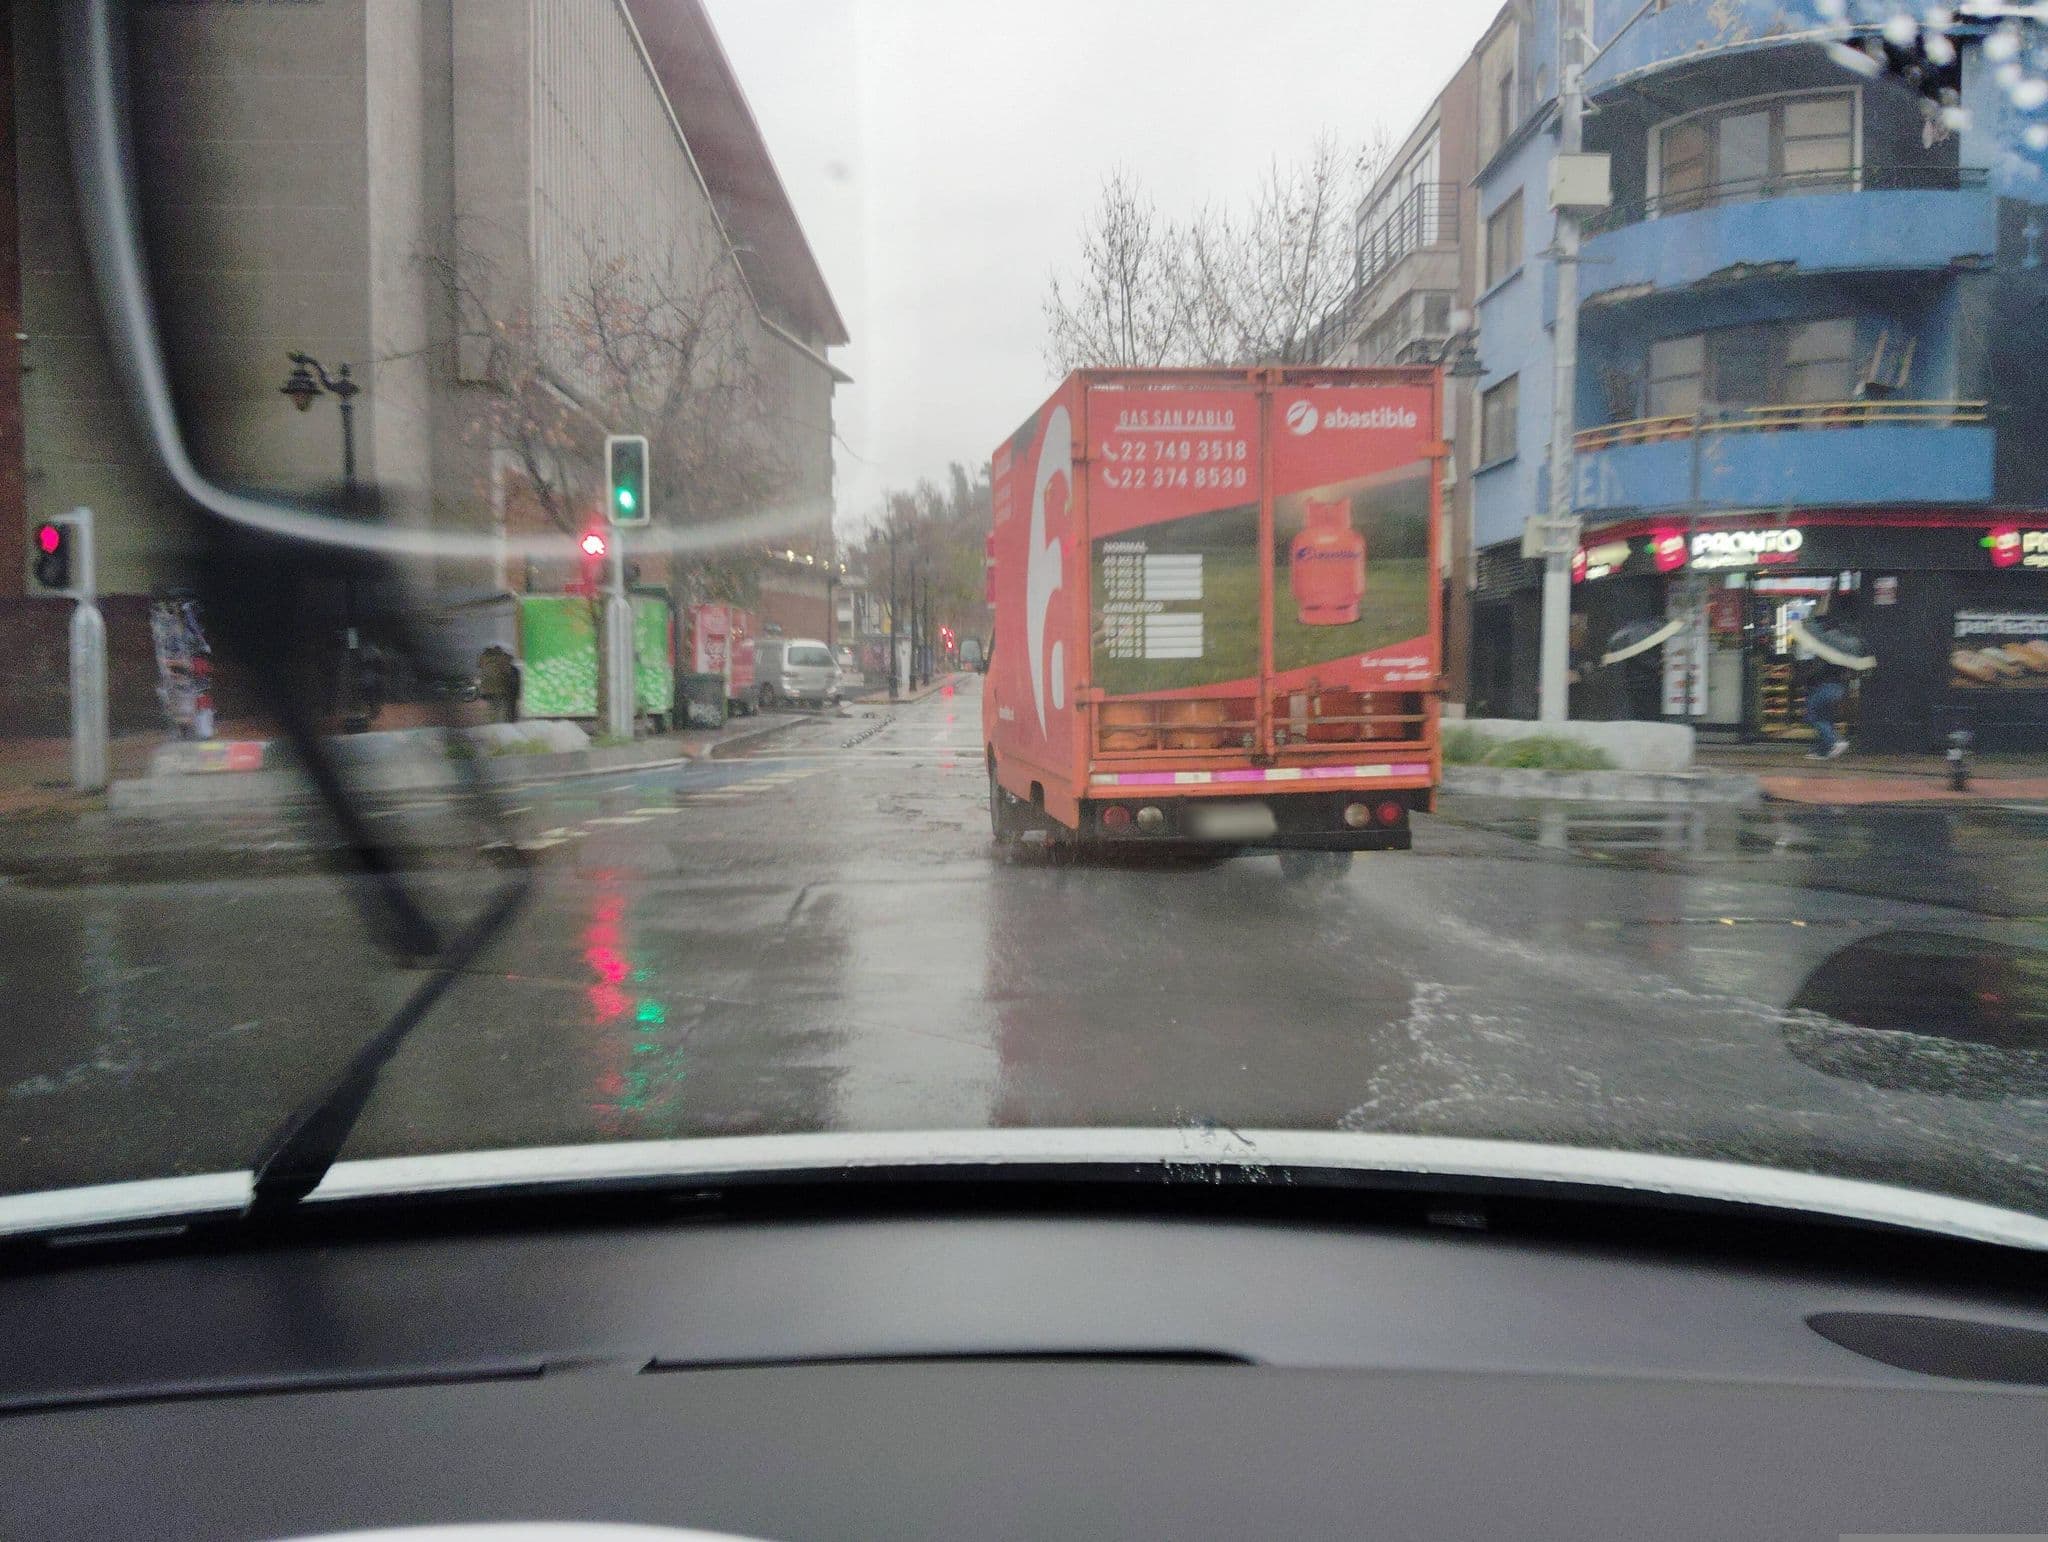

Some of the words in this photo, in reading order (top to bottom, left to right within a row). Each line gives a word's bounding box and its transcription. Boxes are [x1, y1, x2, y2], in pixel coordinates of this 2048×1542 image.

[1119, 409, 1149, 427] GAS
[1153, 409, 1183, 426] SAN
[1186, 409, 1235, 426] PABLO
[1324, 405, 1418, 430] abastible
[1120, 441, 1147, 461] 22
[1199, 440, 1248, 461] 3518
[1120, 467, 1147, 488] 22
[1153, 467, 1189, 488] 374
[1691, 527, 1804, 556] PRONTO
